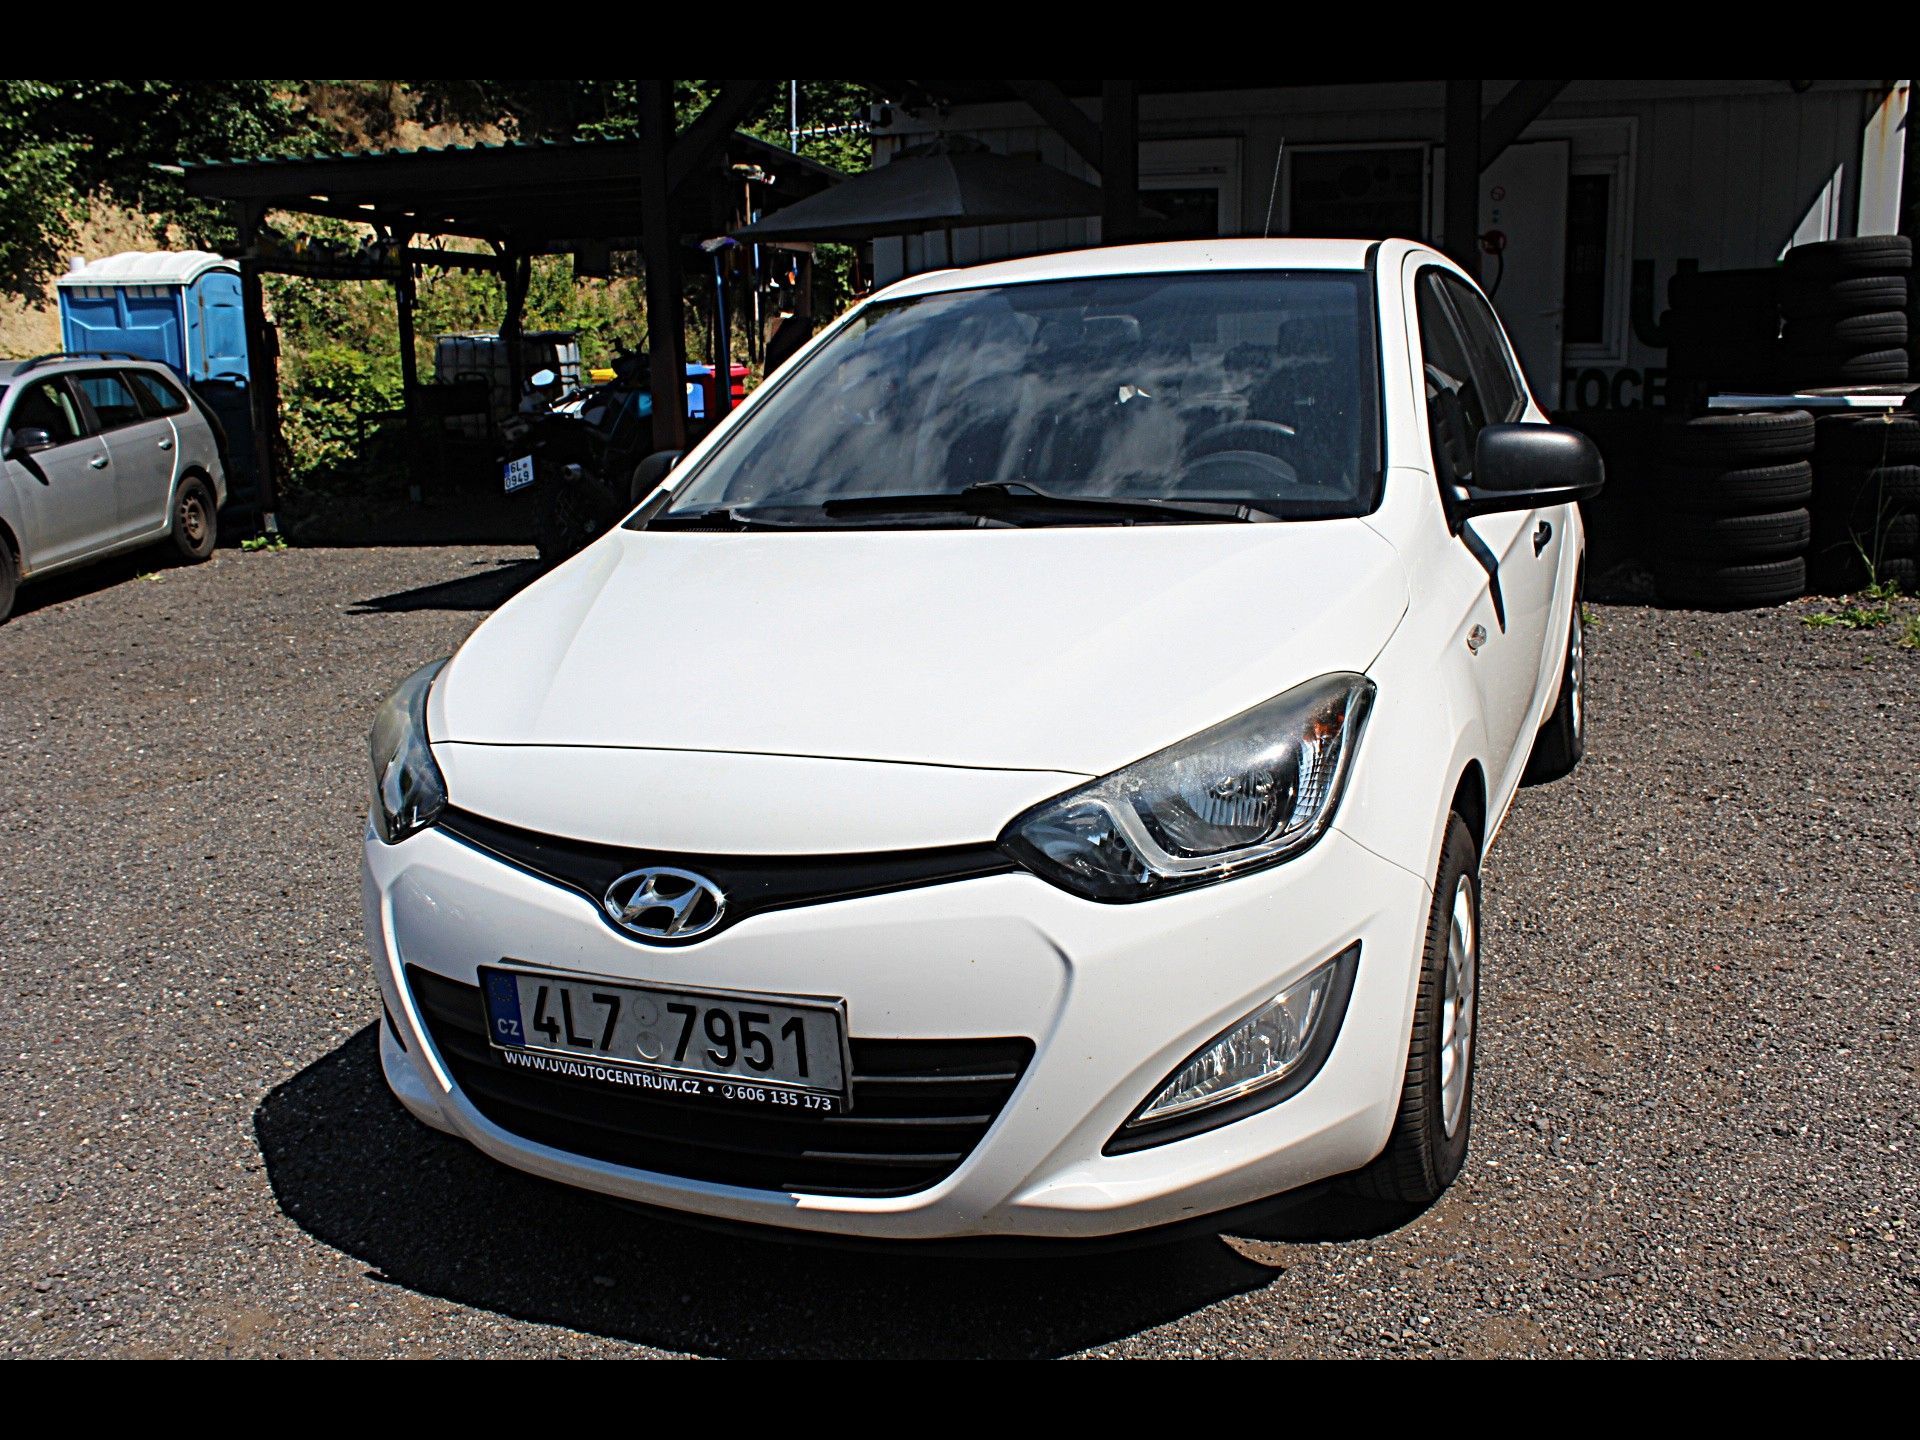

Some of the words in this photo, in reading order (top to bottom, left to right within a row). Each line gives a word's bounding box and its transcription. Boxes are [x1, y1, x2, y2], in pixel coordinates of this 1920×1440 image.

[497, 1018, 520, 1036] CZ
[533, 985, 621, 1051] 4L7
[667, 1002, 809, 1078] 7951
[504, 1051, 701, 1094] WWW.UVAUTOCENTRUM.CZ
[737, 1086, 766, 1102] 606
[770, 1091, 798, 1106] 135
[803, 1095, 832, 1111] 173
